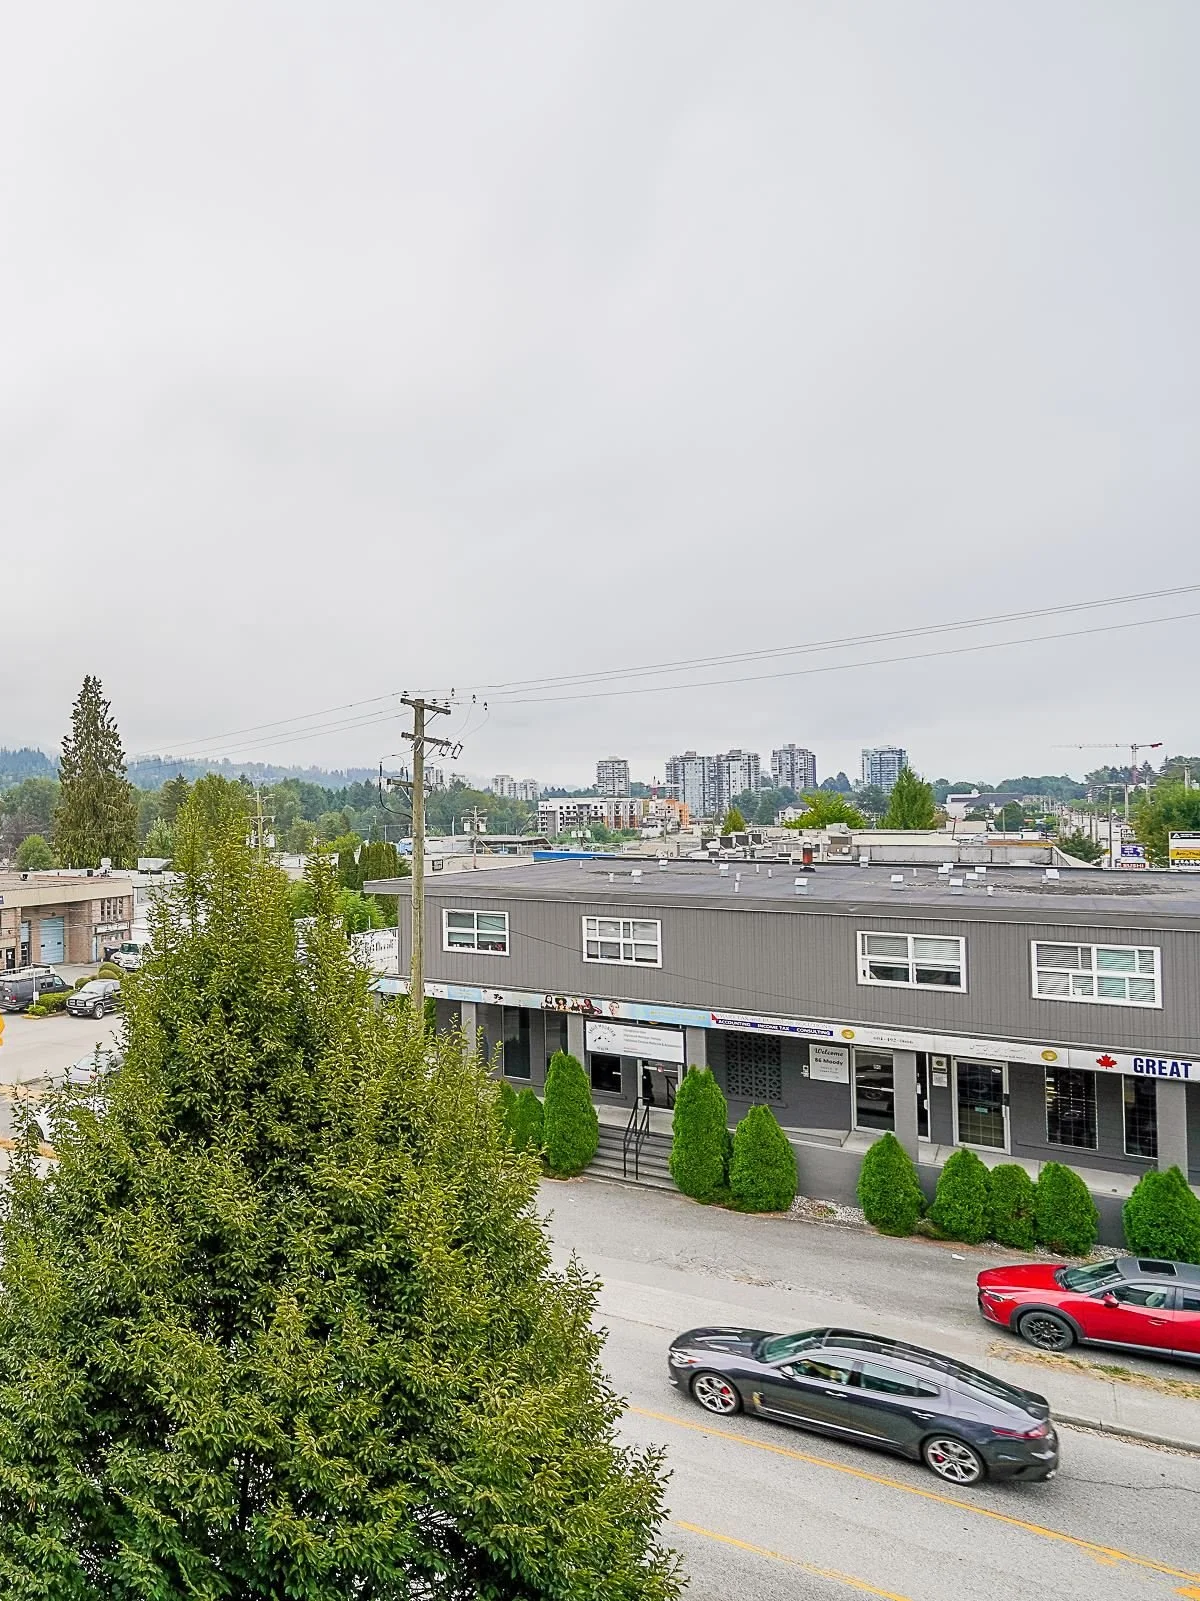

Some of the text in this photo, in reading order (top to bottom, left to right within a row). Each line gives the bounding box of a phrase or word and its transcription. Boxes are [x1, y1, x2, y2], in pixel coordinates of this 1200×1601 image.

[718, 1019, 751, 1028] ACCOUNTING
[757, 1023, 779, 1031] INCOME
[796, 1027, 831, 1036] CONSULTING
[815, 1048, 844, 1057] Welcome
[1133, 1057, 1193, 1079] GREAT
